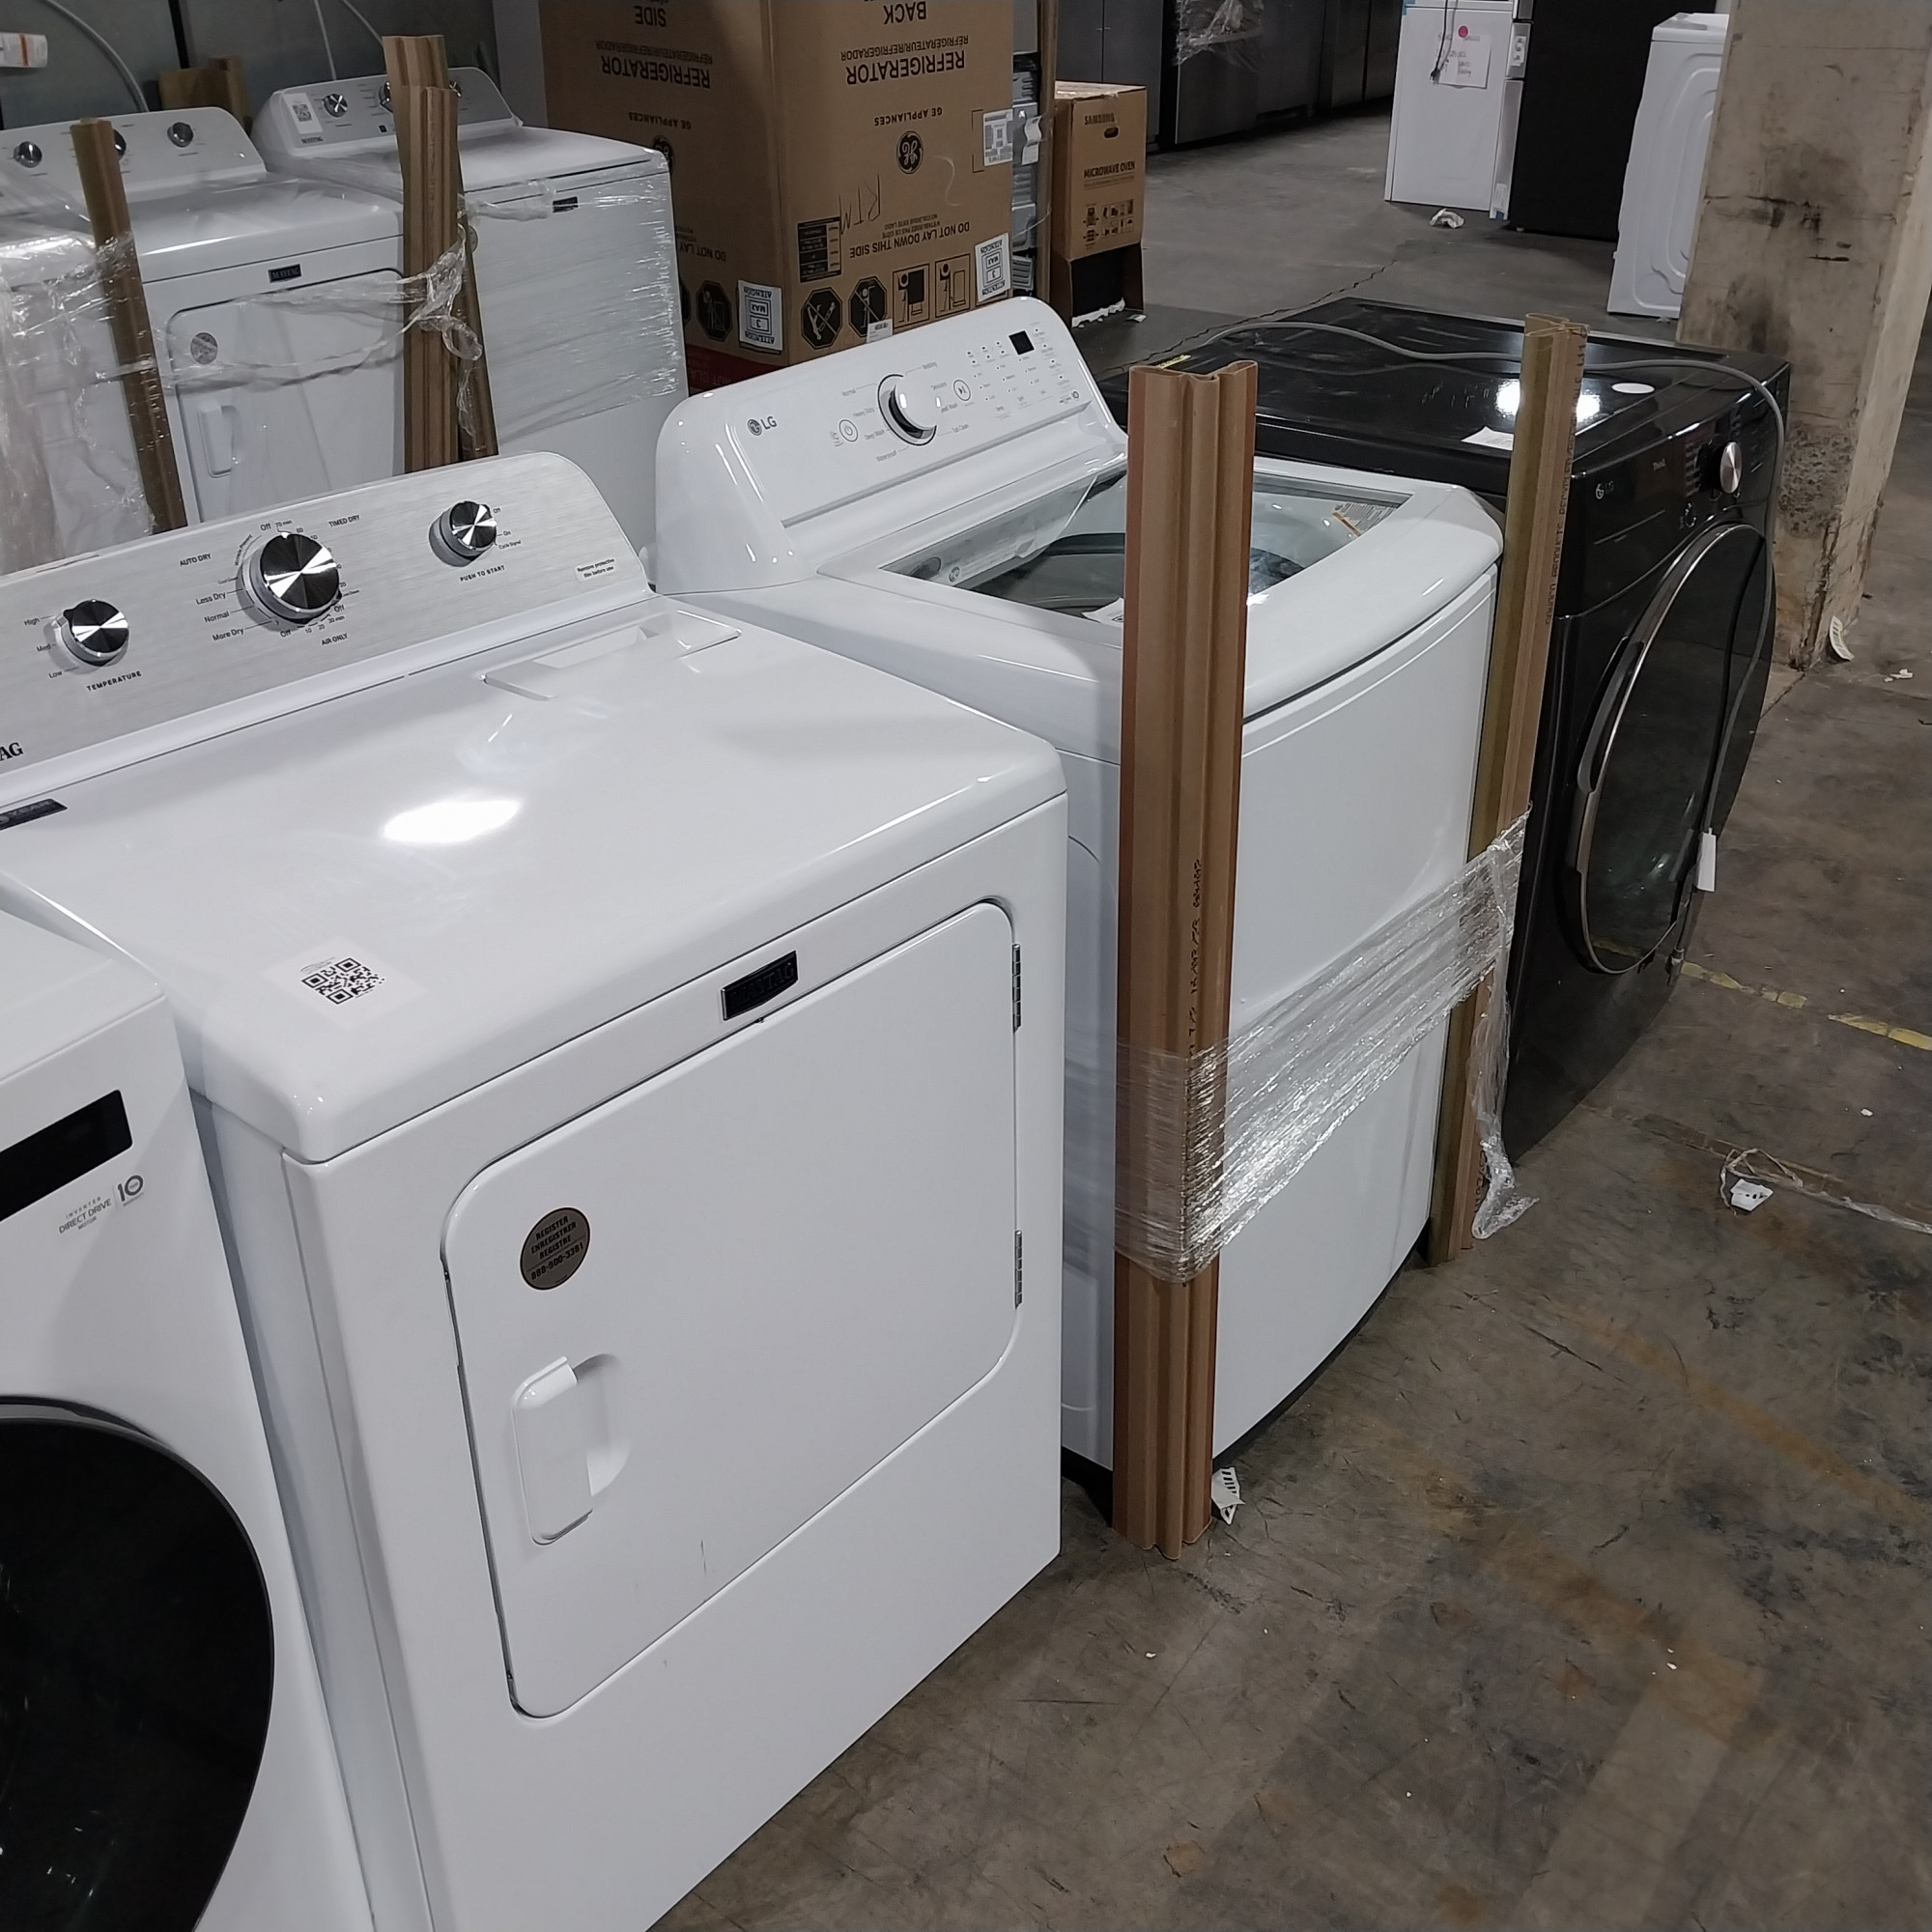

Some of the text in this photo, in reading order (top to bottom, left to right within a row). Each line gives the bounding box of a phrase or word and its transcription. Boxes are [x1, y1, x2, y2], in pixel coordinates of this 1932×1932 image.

[634, 5, 667, 27] SIDE
[883, 1, 927, 25] BACK
[601, 55, 711, 89] REFRIGERATOR
[845, 50, 965, 85] REFRIGERATOR
[628, 111, 692, 129] GE APPLIANCES
[874, 106, 943, 127] GE APPLIANCES
[1084, 113, 1115, 125] SAMSUNG
[1083, 160, 1136, 179] MICROWAVE OVEN
[849, 221, 970, 258] DO NOT LAY DOWN THIS SIDE
[679, 242, 726, 262] DO NOT LAY
[988, 255, 999, 267] MAX
[751, 302, 766, 313] MAX
[760, 415, 778, 431] LG
[260, 523, 271, 531] Off
[327, 514, 360, 528] TIMED DRY
[180, 553, 212, 566] AUTO DRY
[577, 557, 615, 573] Remove protective
[460, 572, 476, 582] PUSH
[487, 565, 505, 576] START
[196, 591, 226, 606] Less Dry
[333, 604, 345, 613] Off
[23, 617, 40, 627] High
[204, 611, 230, 624] Normal
[212, 627, 244, 642] More Dry
[280, 630, 292, 639] Off
[321, 633, 349, 646] AIR ONLY
[36, 643, 50, 653] Med
[48, 669, 63, 679] Low
[86, 670, 142, 693] TEMPERATURE
[117, 1175, 144, 1202] 10
[66, 1196, 101, 1219] INVERTER
[58, 1211, 87, 1234] DIRECT
[87, 1198, 112, 1217] DRIVE
[77, 1215, 98, 1230] MOTOR
[535, 1215, 569, 1241] REGISTER
[530, 1221, 577, 1254] ENREGISTRER
[539, 1235, 572, 1260] REGISTRE
